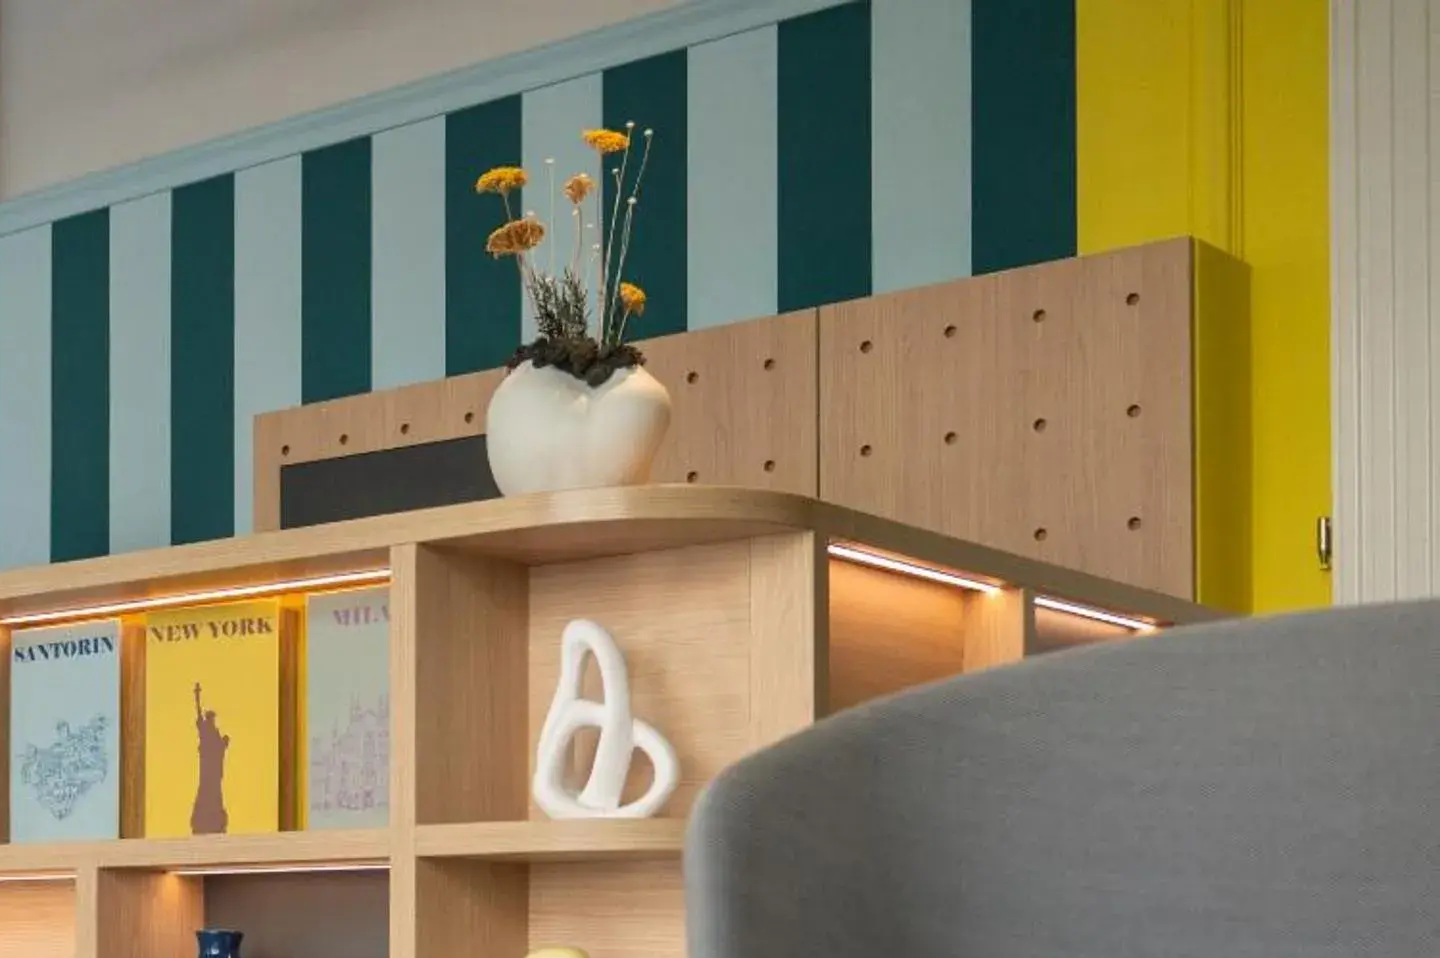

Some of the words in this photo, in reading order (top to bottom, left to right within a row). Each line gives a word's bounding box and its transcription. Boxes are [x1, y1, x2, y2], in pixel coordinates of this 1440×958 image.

[150, 623, 201, 642] NEW
[207, 617, 274, 639] YORK
[14, 636, 115, 662] SANTORIN
